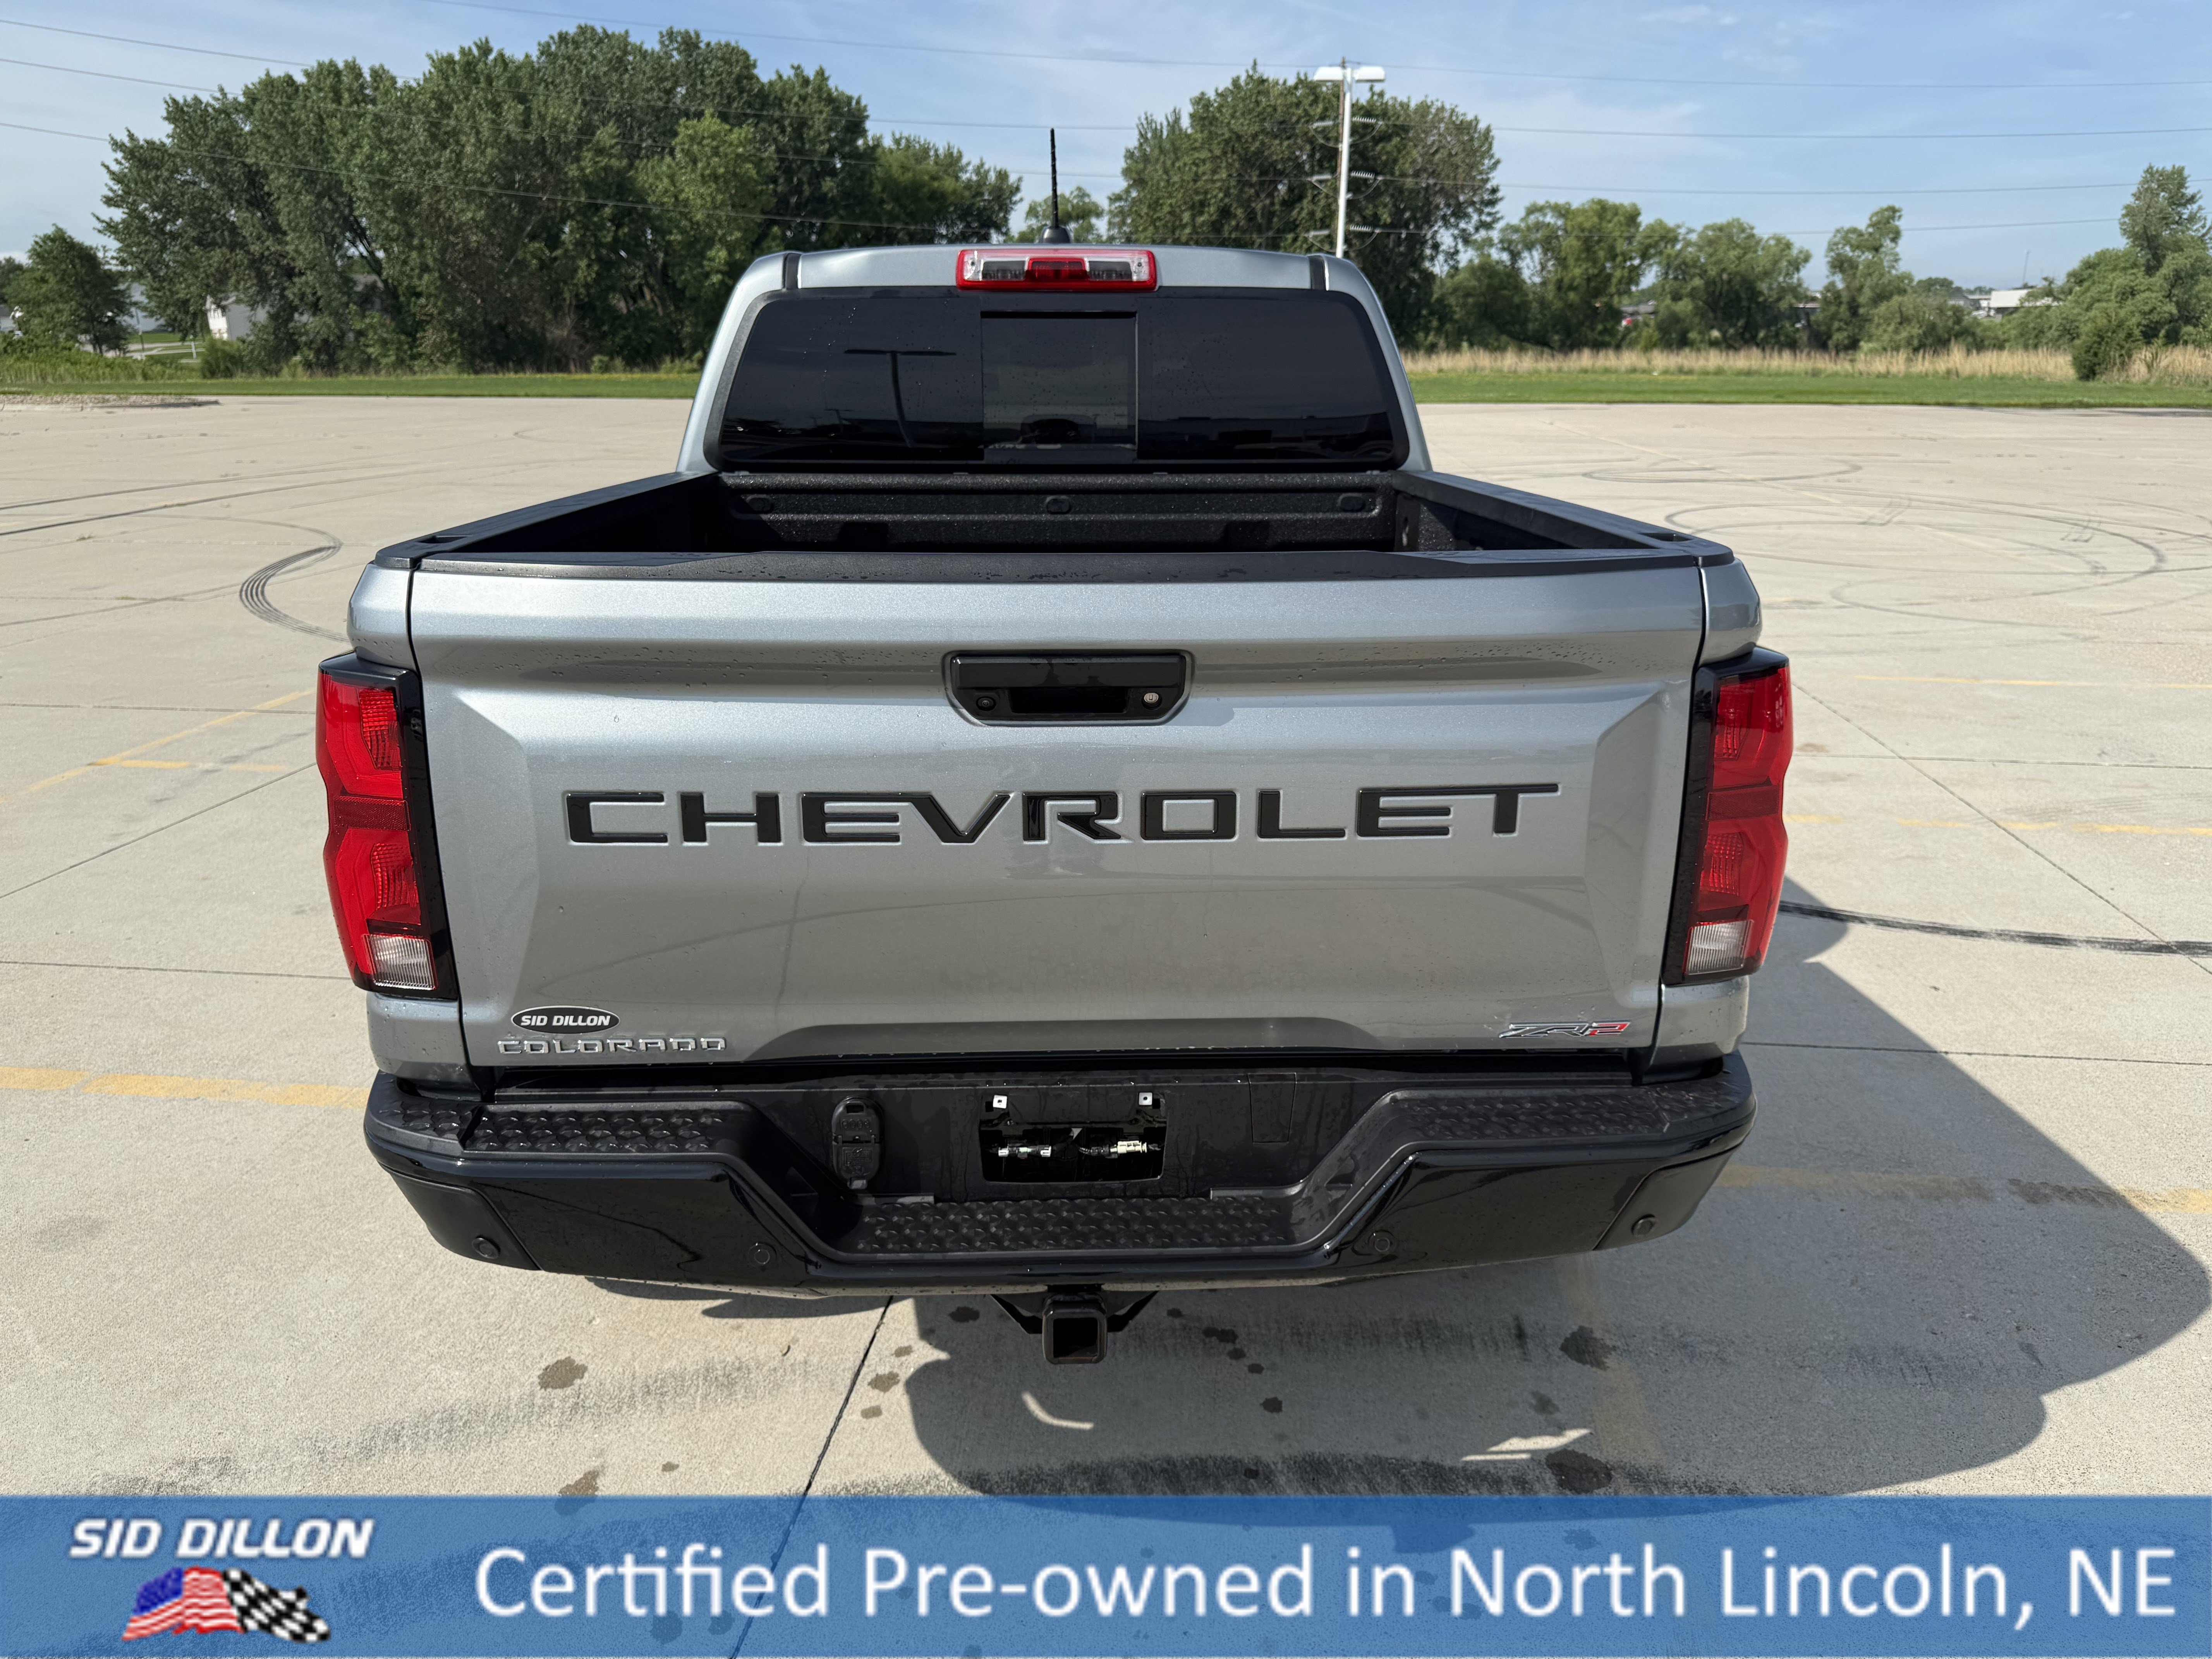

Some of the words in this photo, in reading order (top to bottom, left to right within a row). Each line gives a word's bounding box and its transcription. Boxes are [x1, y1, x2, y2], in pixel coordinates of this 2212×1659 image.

[565, 783, 1559, 844] CHEVROLET
[520, 1015, 548, 1026] SID
[551, 1015, 611, 1026] DILLON
[1499, 1020, 1631, 1038] ZR2
[497, 1036, 727, 1054] COLORADO
